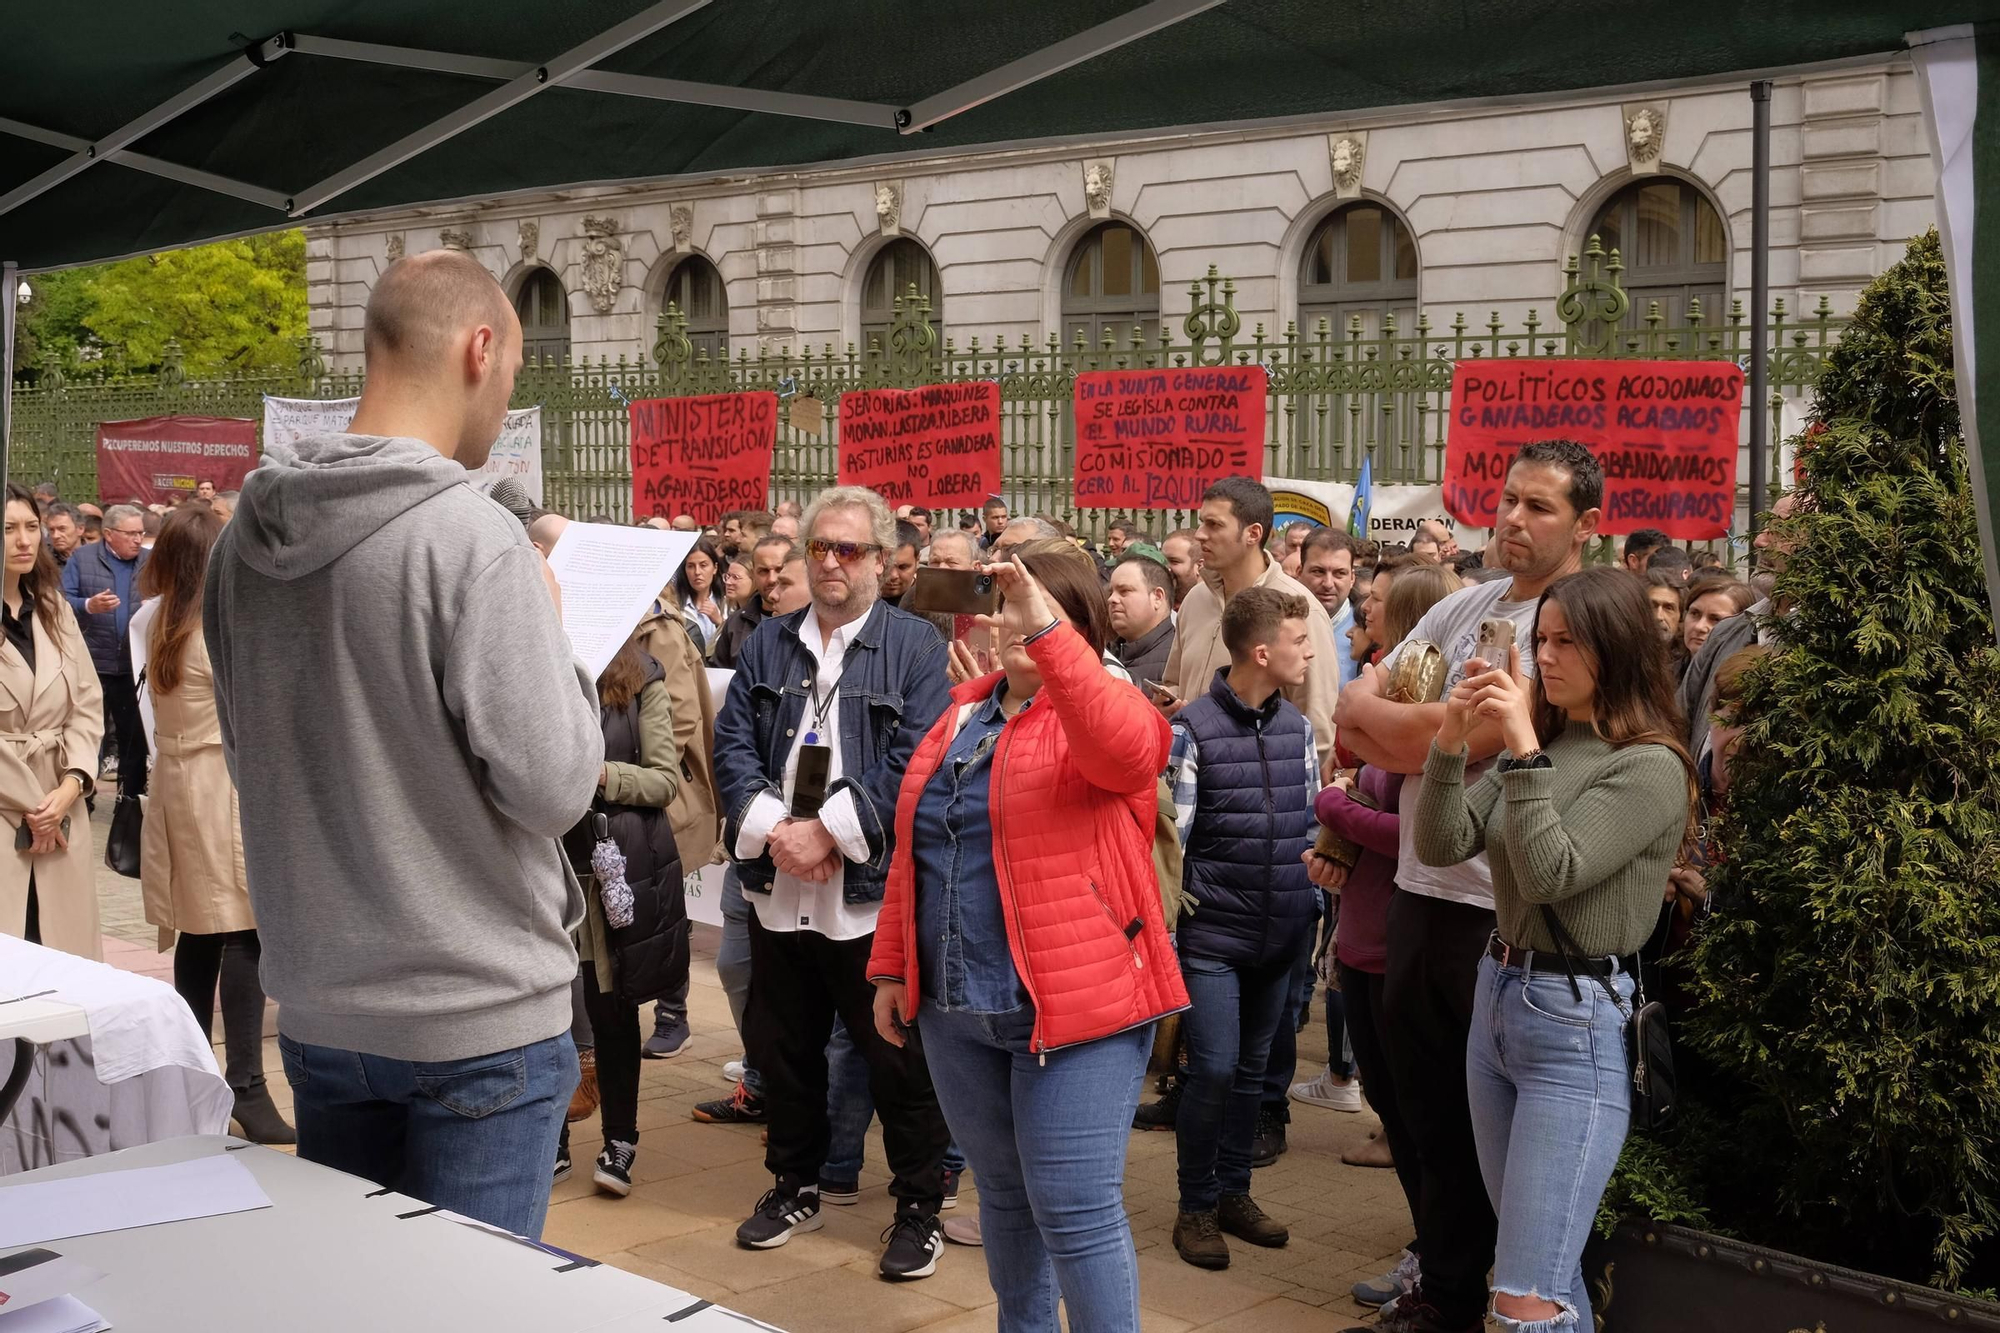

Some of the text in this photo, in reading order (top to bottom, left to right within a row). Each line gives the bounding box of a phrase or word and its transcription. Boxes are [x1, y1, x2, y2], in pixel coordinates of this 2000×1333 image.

[1081, 374, 1252, 400] EN LA JUNTA GENERAL
[1464, 370, 1740, 402] POLITICOS ACOJONAOS
[635, 396, 769, 440] MINISTERIO
[1093, 395, 1239, 419] SE LEGISLA CONTRA
[1459, 404, 1724, 434] GANADEROS ACABAOS
[1087, 412, 1247, 440] EL MUNDO RURAL
[161, 441, 201, 454] NUESTROS
[203, 444, 250, 457] DERECHOS
[846, 432, 995, 473] ASTURIAS ES GANADERA
[1080, 443, 1224, 472] COMISIONADO
[908, 465, 928, 478] NO
[1600, 452, 1731, 486] ABANDONAOS
[928, 472, 981, 497] LOBERA
[1077, 476, 1114, 496] CERO
[1122, 476, 1140, 493] AL
[1607, 489, 1729, 523] ASEGURAOS
